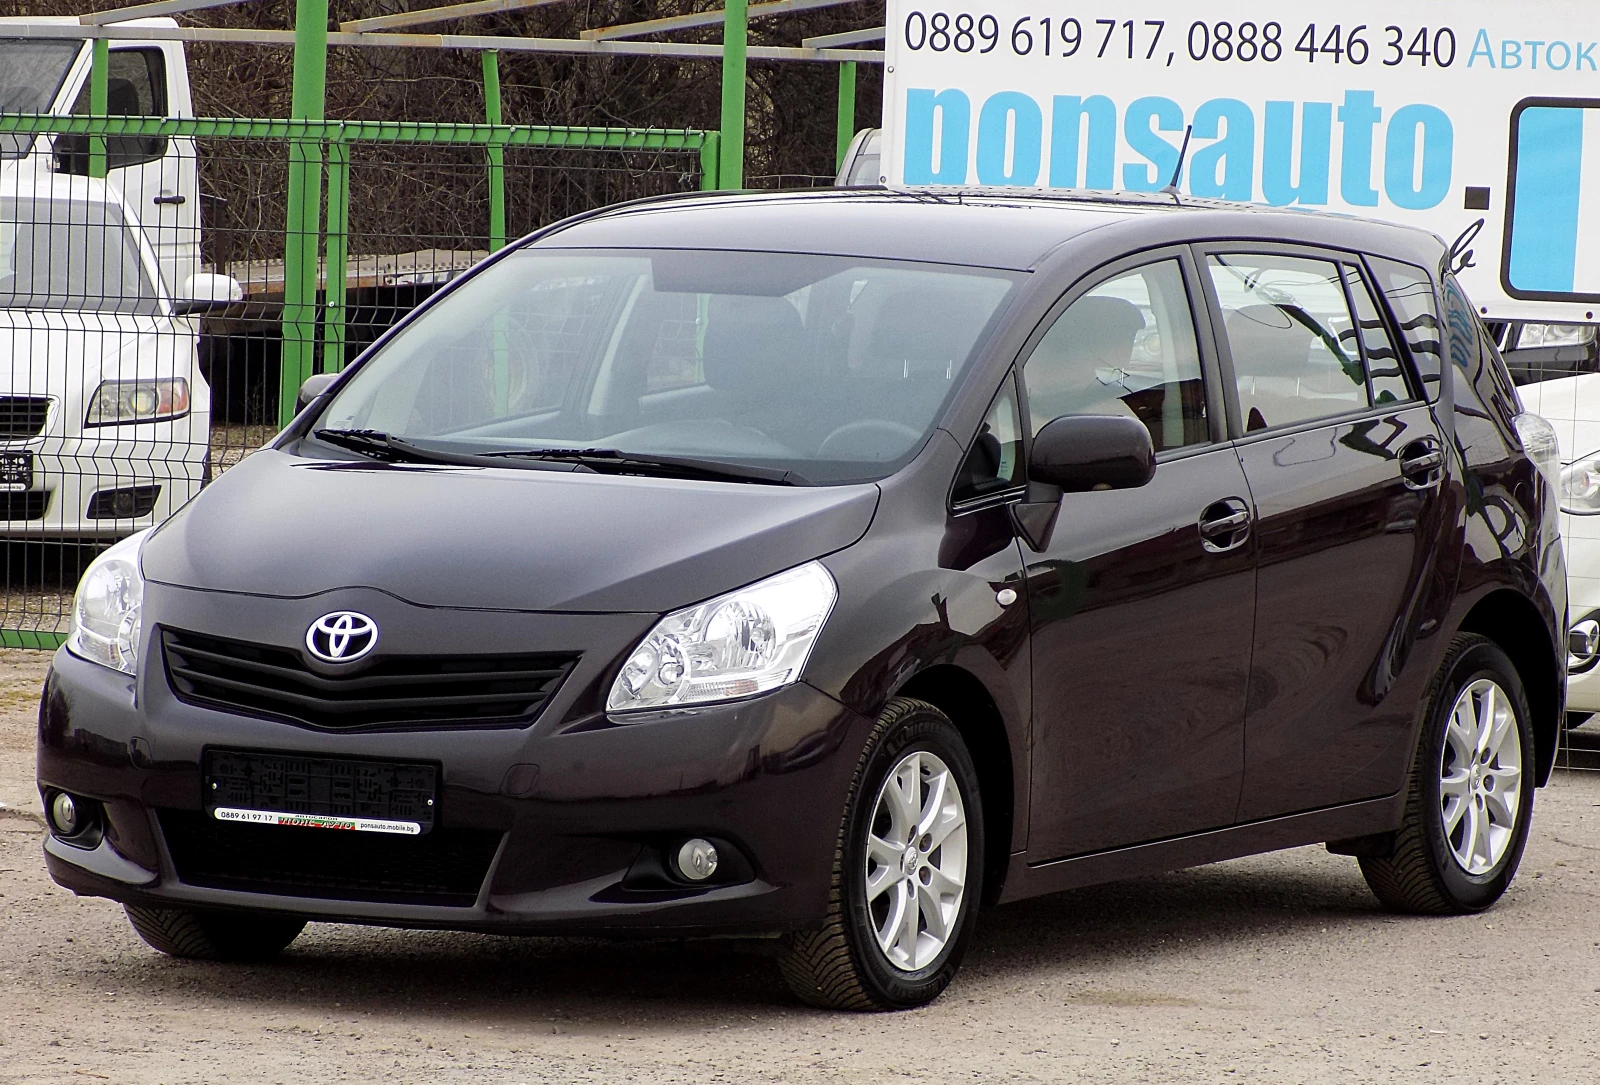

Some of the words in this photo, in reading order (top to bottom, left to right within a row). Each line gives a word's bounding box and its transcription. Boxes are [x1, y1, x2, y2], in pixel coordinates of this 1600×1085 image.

[905, 10, 998, 54] 0889
[1012, 15, 1082, 57] 619
[1096, 20, 1175, 66] 717,
[1188, 21, 1282, 62] 0888
[1295, 24, 1369, 65] 446
[1383, 26, 1456, 67] 340
[221, 811, 240, 819] 0889
[241, 812, 250, 820] 61
[252, 813, 262, 821] 97
[264, 814, 273, 822] 17
[360, 822, 415, 833] ponsauto.mobile.bg
